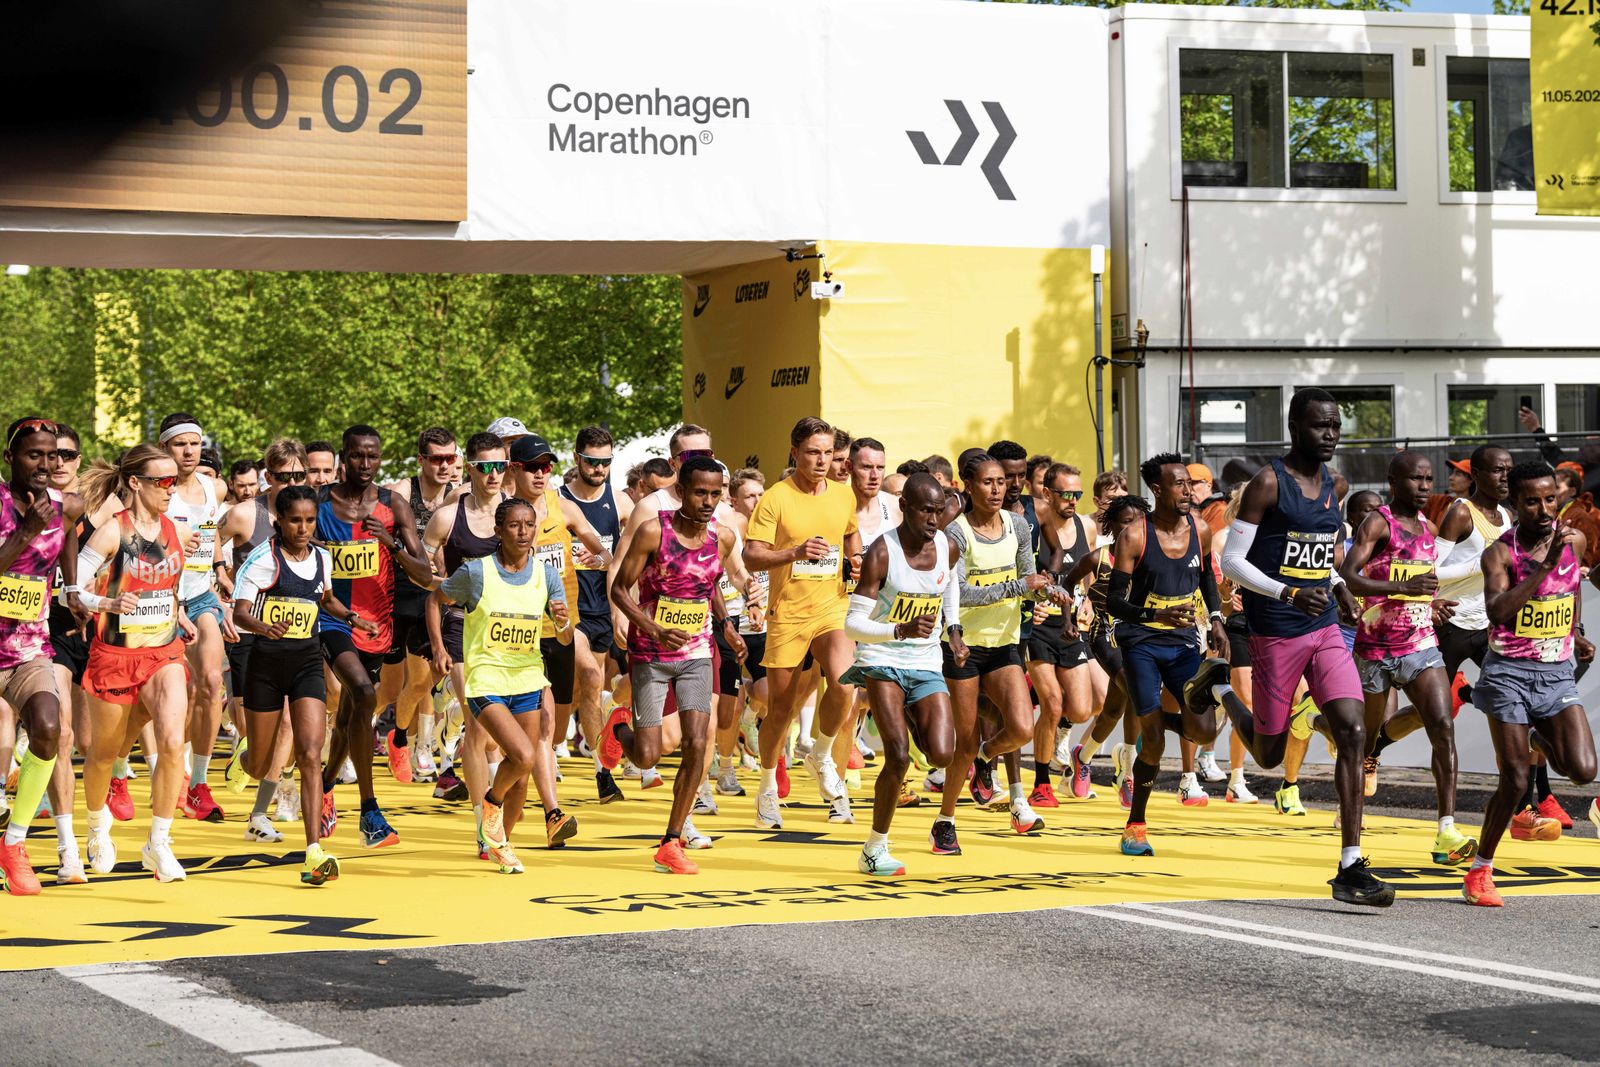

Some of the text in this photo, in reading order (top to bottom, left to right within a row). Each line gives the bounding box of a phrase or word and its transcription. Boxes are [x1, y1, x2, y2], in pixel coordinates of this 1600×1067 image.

[547, 83, 750, 125] Copenhagen
[771, 366, 810, 388] LØBEREN
[332, 546, 375, 572] Korir
[1283, 541, 1334, 568] PACE
[0, 580, 42, 611] esfaye
[270, 604, 311, 632] Gidey
[659, 606, 704, 625] Tadesse
[1520, 602, 1572, 629] Bantie
[490, 621, 537, 644] Getnet
[528, 871, 1184, 904] Copenhagen
